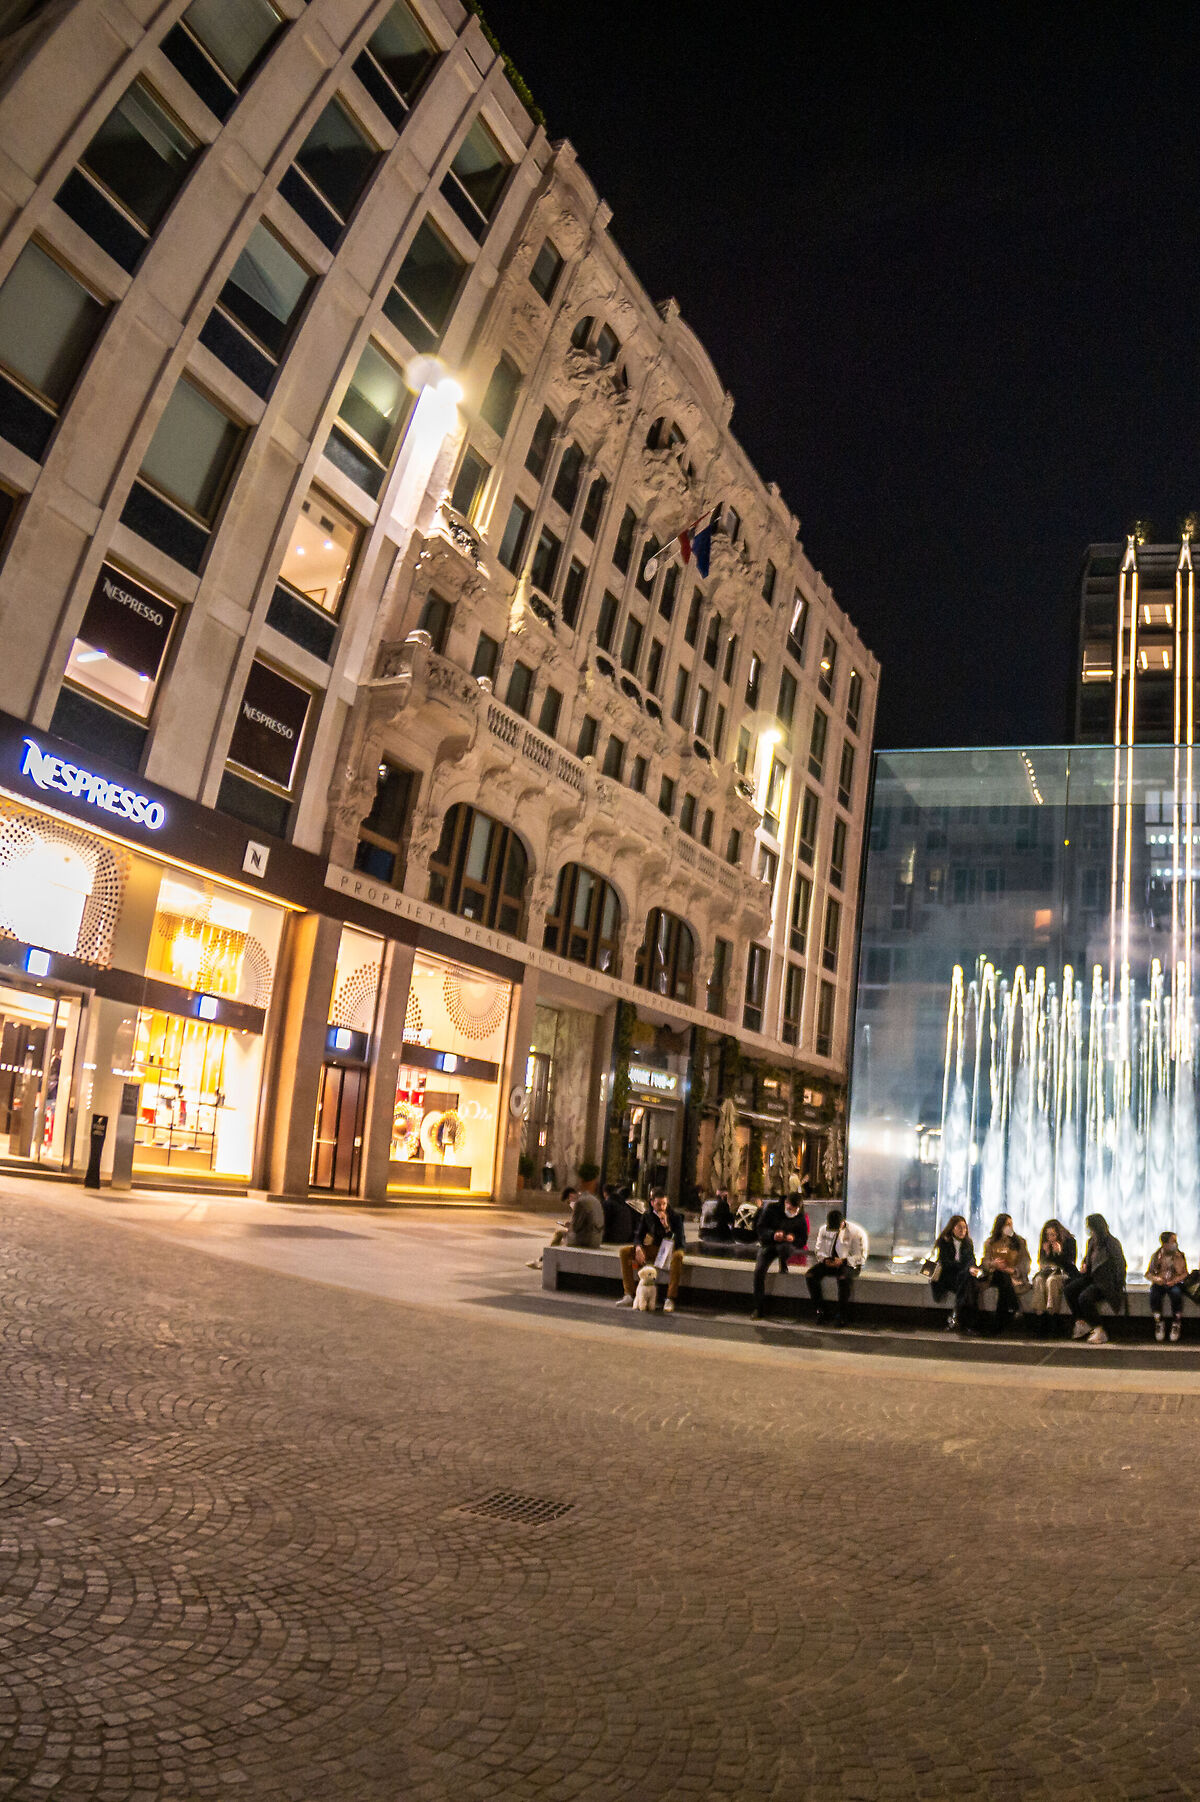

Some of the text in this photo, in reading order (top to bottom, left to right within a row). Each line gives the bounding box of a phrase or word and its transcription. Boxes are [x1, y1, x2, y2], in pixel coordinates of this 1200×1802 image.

[103, 577, 164, 627] NESPRESSO
[243, 701, 294, 740] NESPRESSO
[23, 738, 166, 830] NESPRESSO
[250, 848, 262, 870] N
[464, 926, 513, 953] REALE
